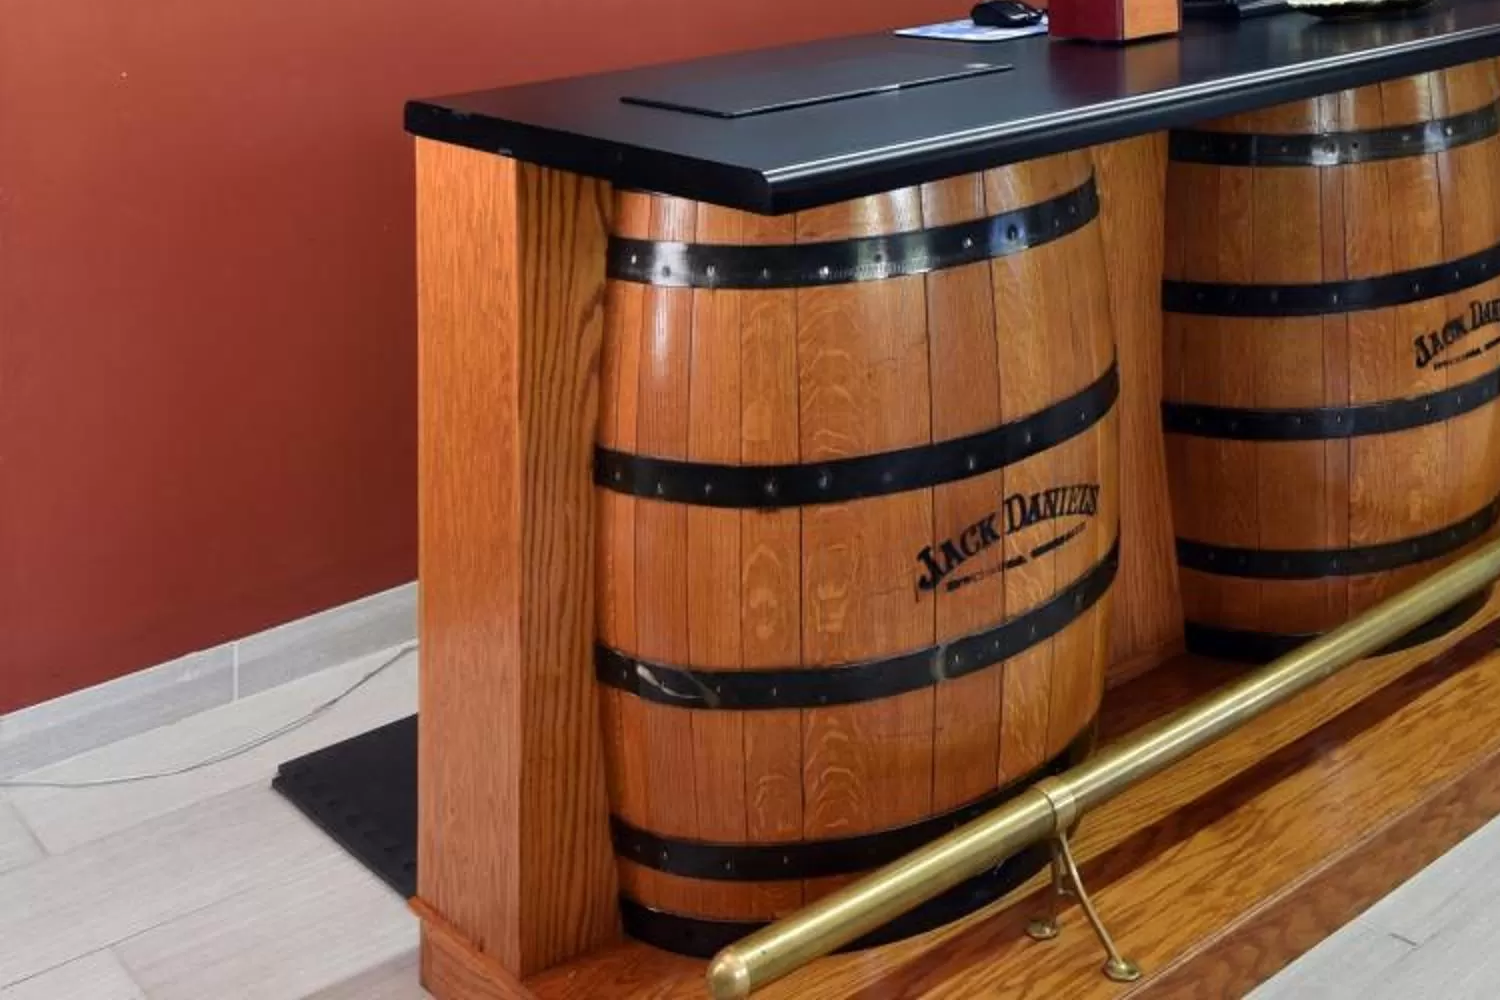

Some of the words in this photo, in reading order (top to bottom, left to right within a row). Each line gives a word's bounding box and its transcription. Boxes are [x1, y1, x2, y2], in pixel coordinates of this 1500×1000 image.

[1413, 313, 1468, 369] JACK
[917, 511, 1001, 591] JACK
[1003, 483, 1100, 536] DANIELS
